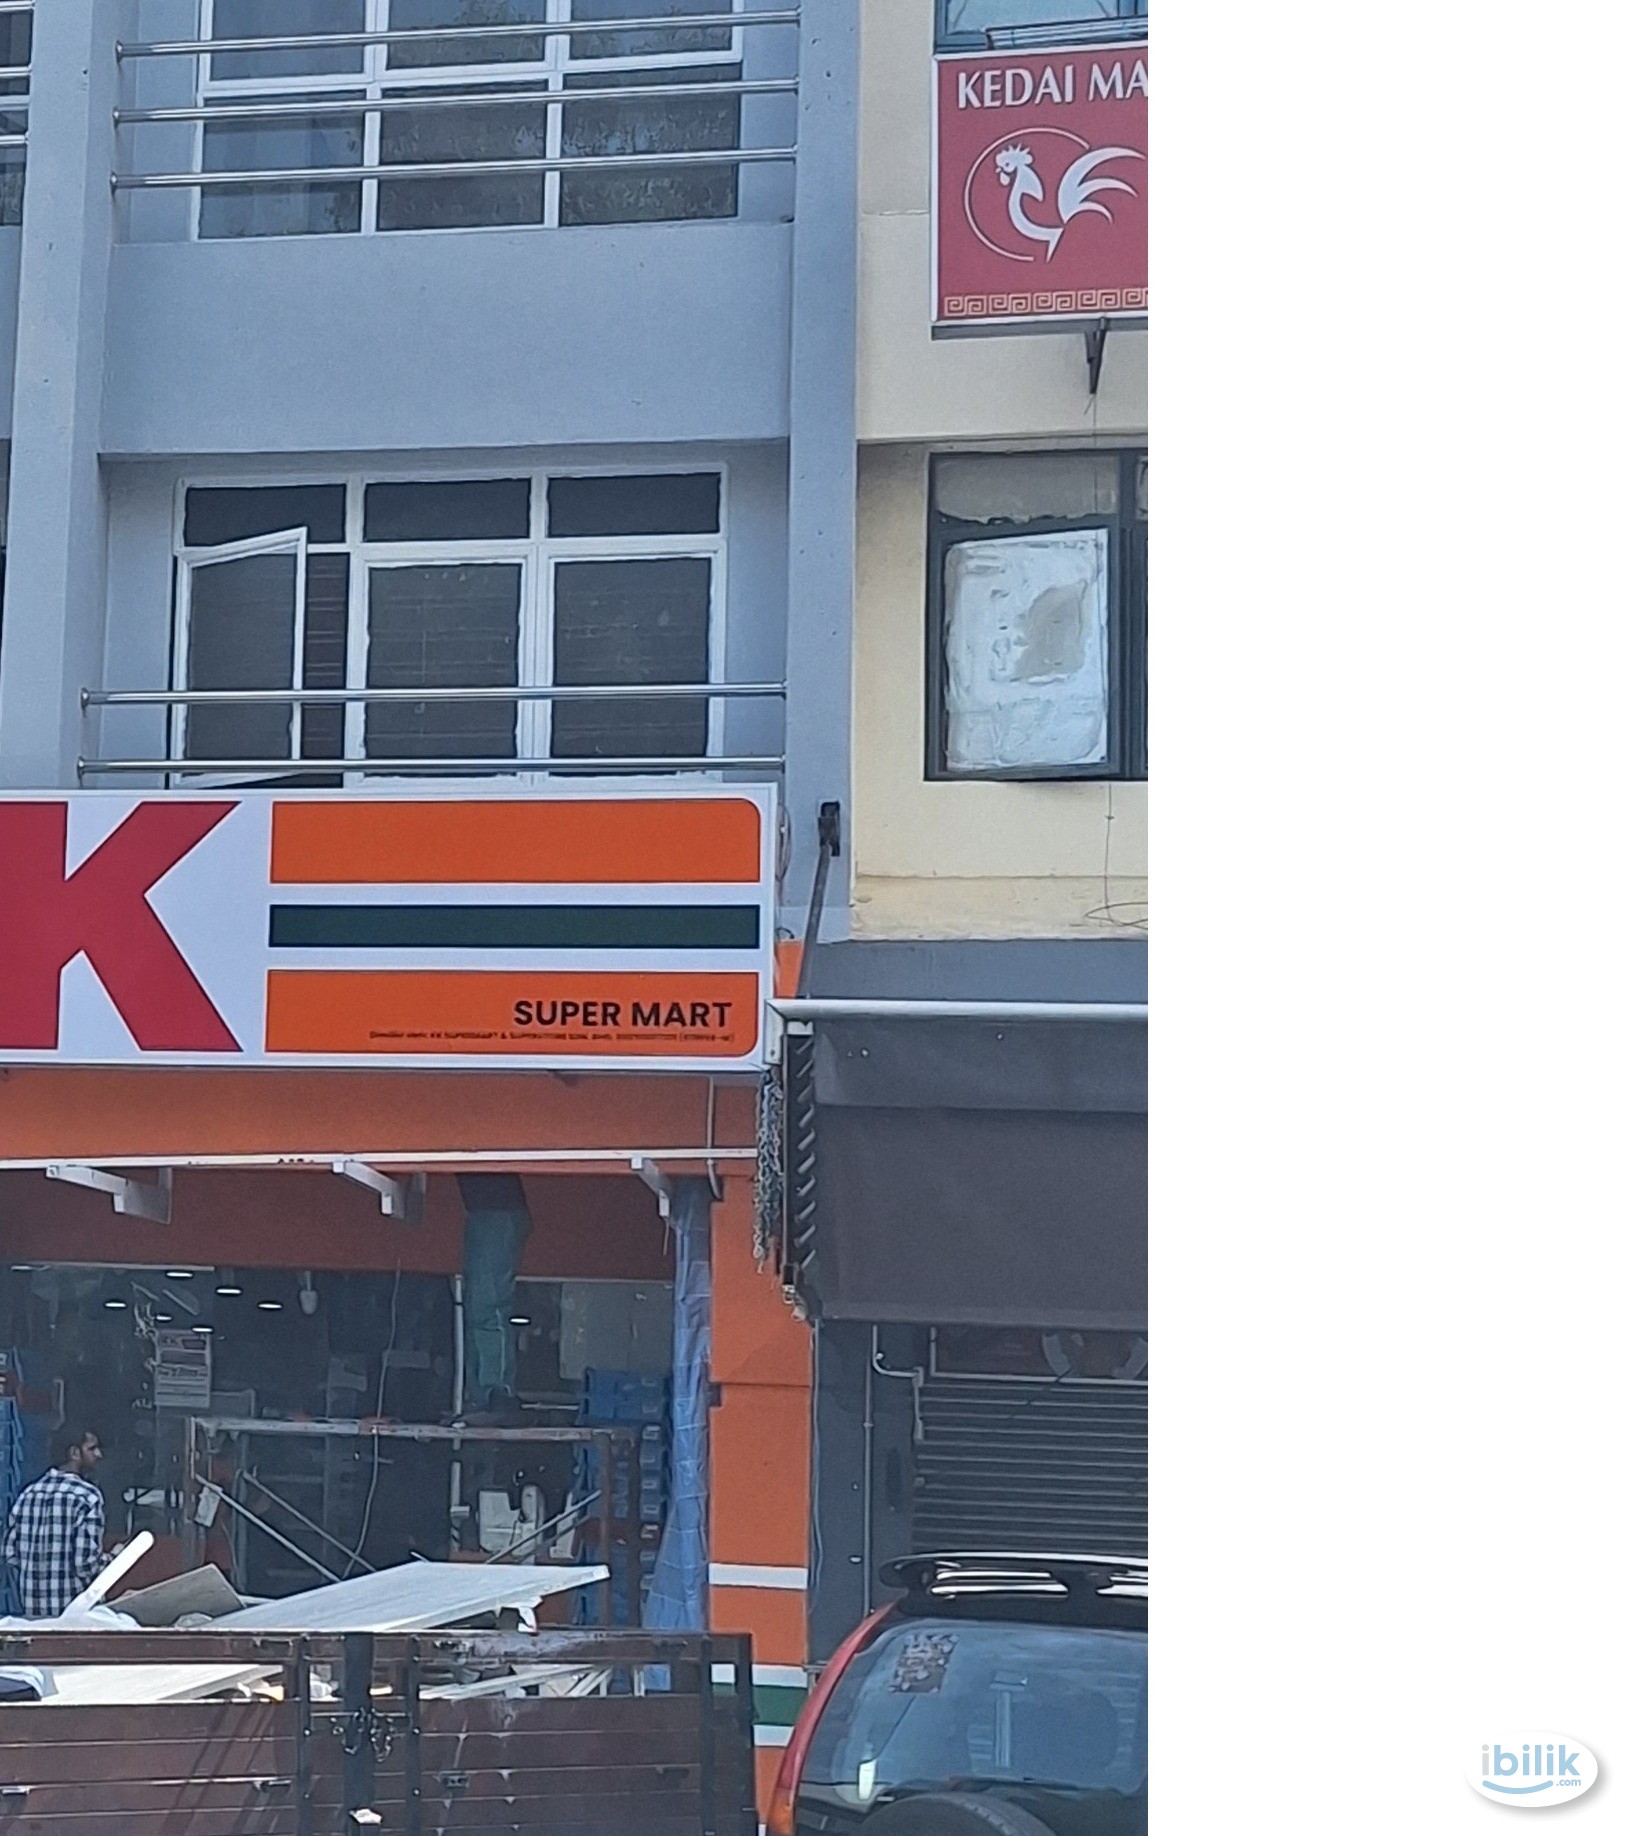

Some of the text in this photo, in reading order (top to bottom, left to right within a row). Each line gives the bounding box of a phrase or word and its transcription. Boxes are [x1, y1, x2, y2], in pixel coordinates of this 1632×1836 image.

[958, 60, 1148, 109] KEDAI MA
[514, 1001, 732, 1028] SUPER MART
